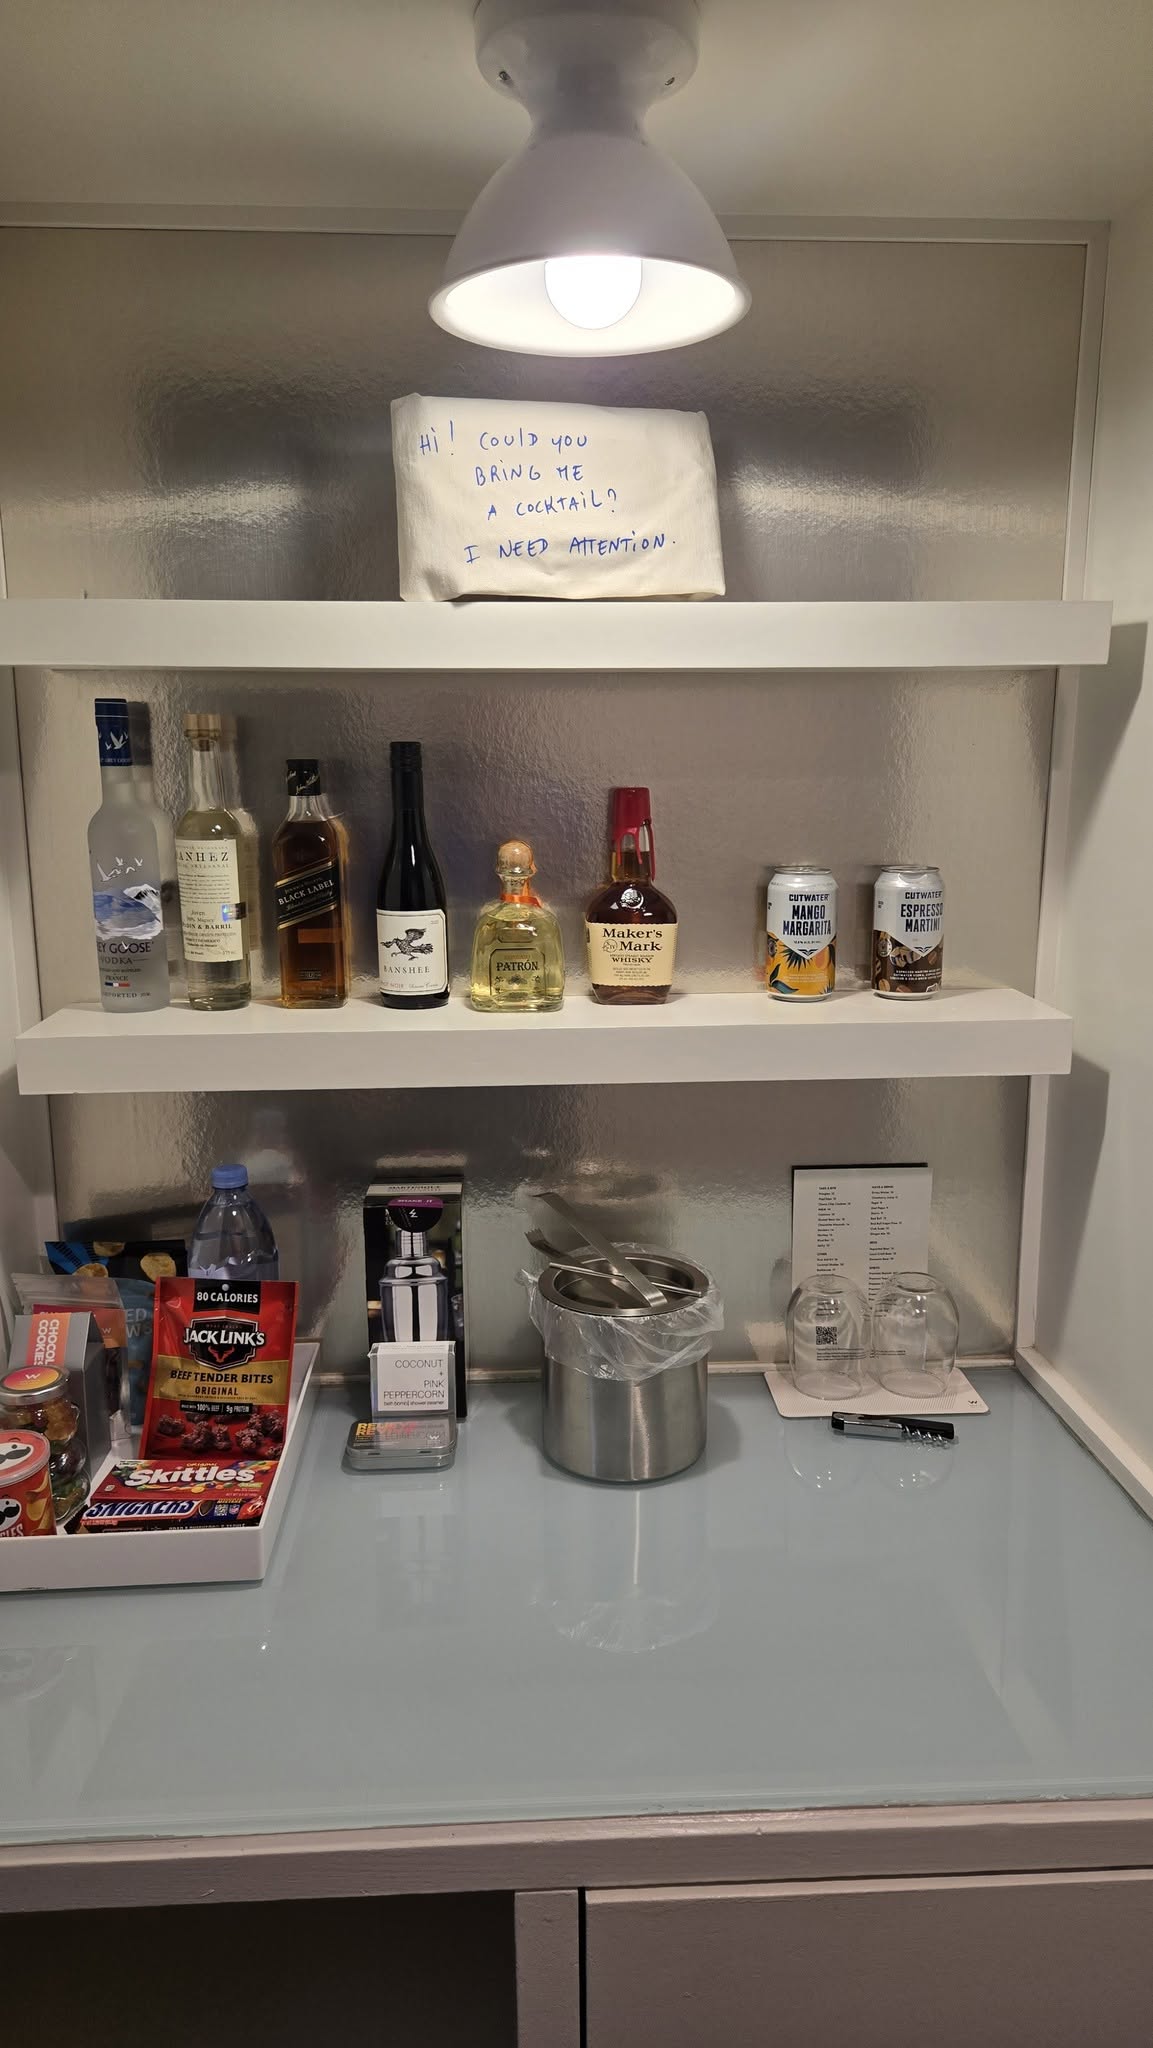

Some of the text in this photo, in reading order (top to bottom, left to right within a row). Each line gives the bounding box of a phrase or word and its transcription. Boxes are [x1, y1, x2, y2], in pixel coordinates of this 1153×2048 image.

[556, 464, 583, 481] ME
[487, 504, 497, 520] A
[464, 545, 480, 563] I
[499, 539, 549, 558] NEED
[178, 851, 229, 862] ANHEZ
[278, 889, 306, 905] BLACK
[307, 879, 335, 894] LABEL
[789, 894, 829, 902] CUTWATER
[792, 904, 826, 920] MANGO
[783, 920, 832, 936] MARGARITA
[905, 917, 941, 933] MARTINI
[602, 928, 663, 939] Maker's
[109, 941, 152, 954] GOOSE
[619, 941, 662, 951] Mark
[383, 964, 430, 974] BANSHEE
[496, 959, 539, 971] PATRÓN
[196, 1292, 258, 1303] 80 CALORIES
[45, 1319, 60, 1366] CHOCOL
[184, 1328, 265, 1347] JACK LINK'S
[395, 1359, 444, 1368] COCONUT
[170, 1370, 273, 1384] BEEF TENDER BITES
[424, 1380, 446, 1388] PINK
[195, 1386, 239, 1396] ORIGINAL
[383, 1390, 445, 1399] PEPPERCORN
[197, 1403, 210, 1412] 100%
[125, 1466, 255, 1487] Skittles
[86, 1501, 197, 1518] SNICKERS
